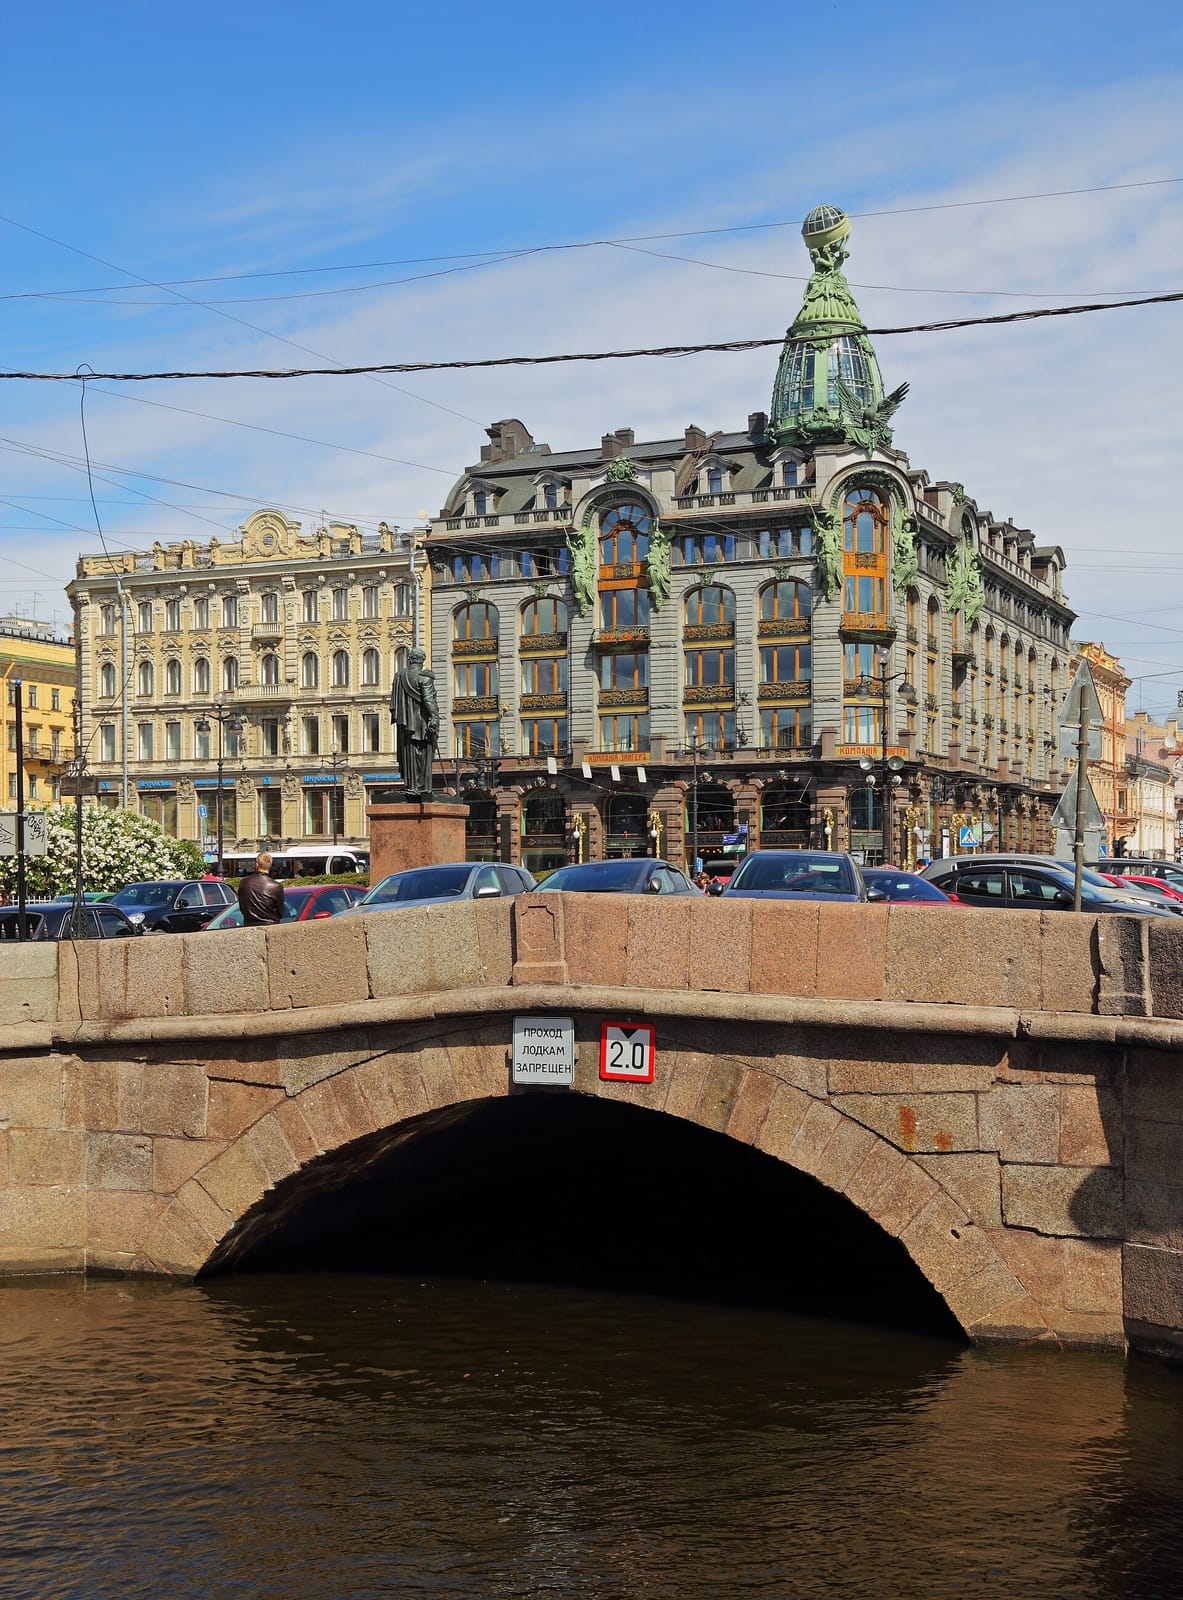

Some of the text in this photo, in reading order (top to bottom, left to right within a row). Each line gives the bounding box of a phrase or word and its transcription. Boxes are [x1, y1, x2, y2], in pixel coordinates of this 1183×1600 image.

[523, 1027, 563, 1039] ПРОХОД
[522, 1045, 565, 1056] ЛОДКАМ
[610, 1041, 645, 1070] 2.0
[516, 1063, 571, 1074] ЗАПРЕЩЕН
